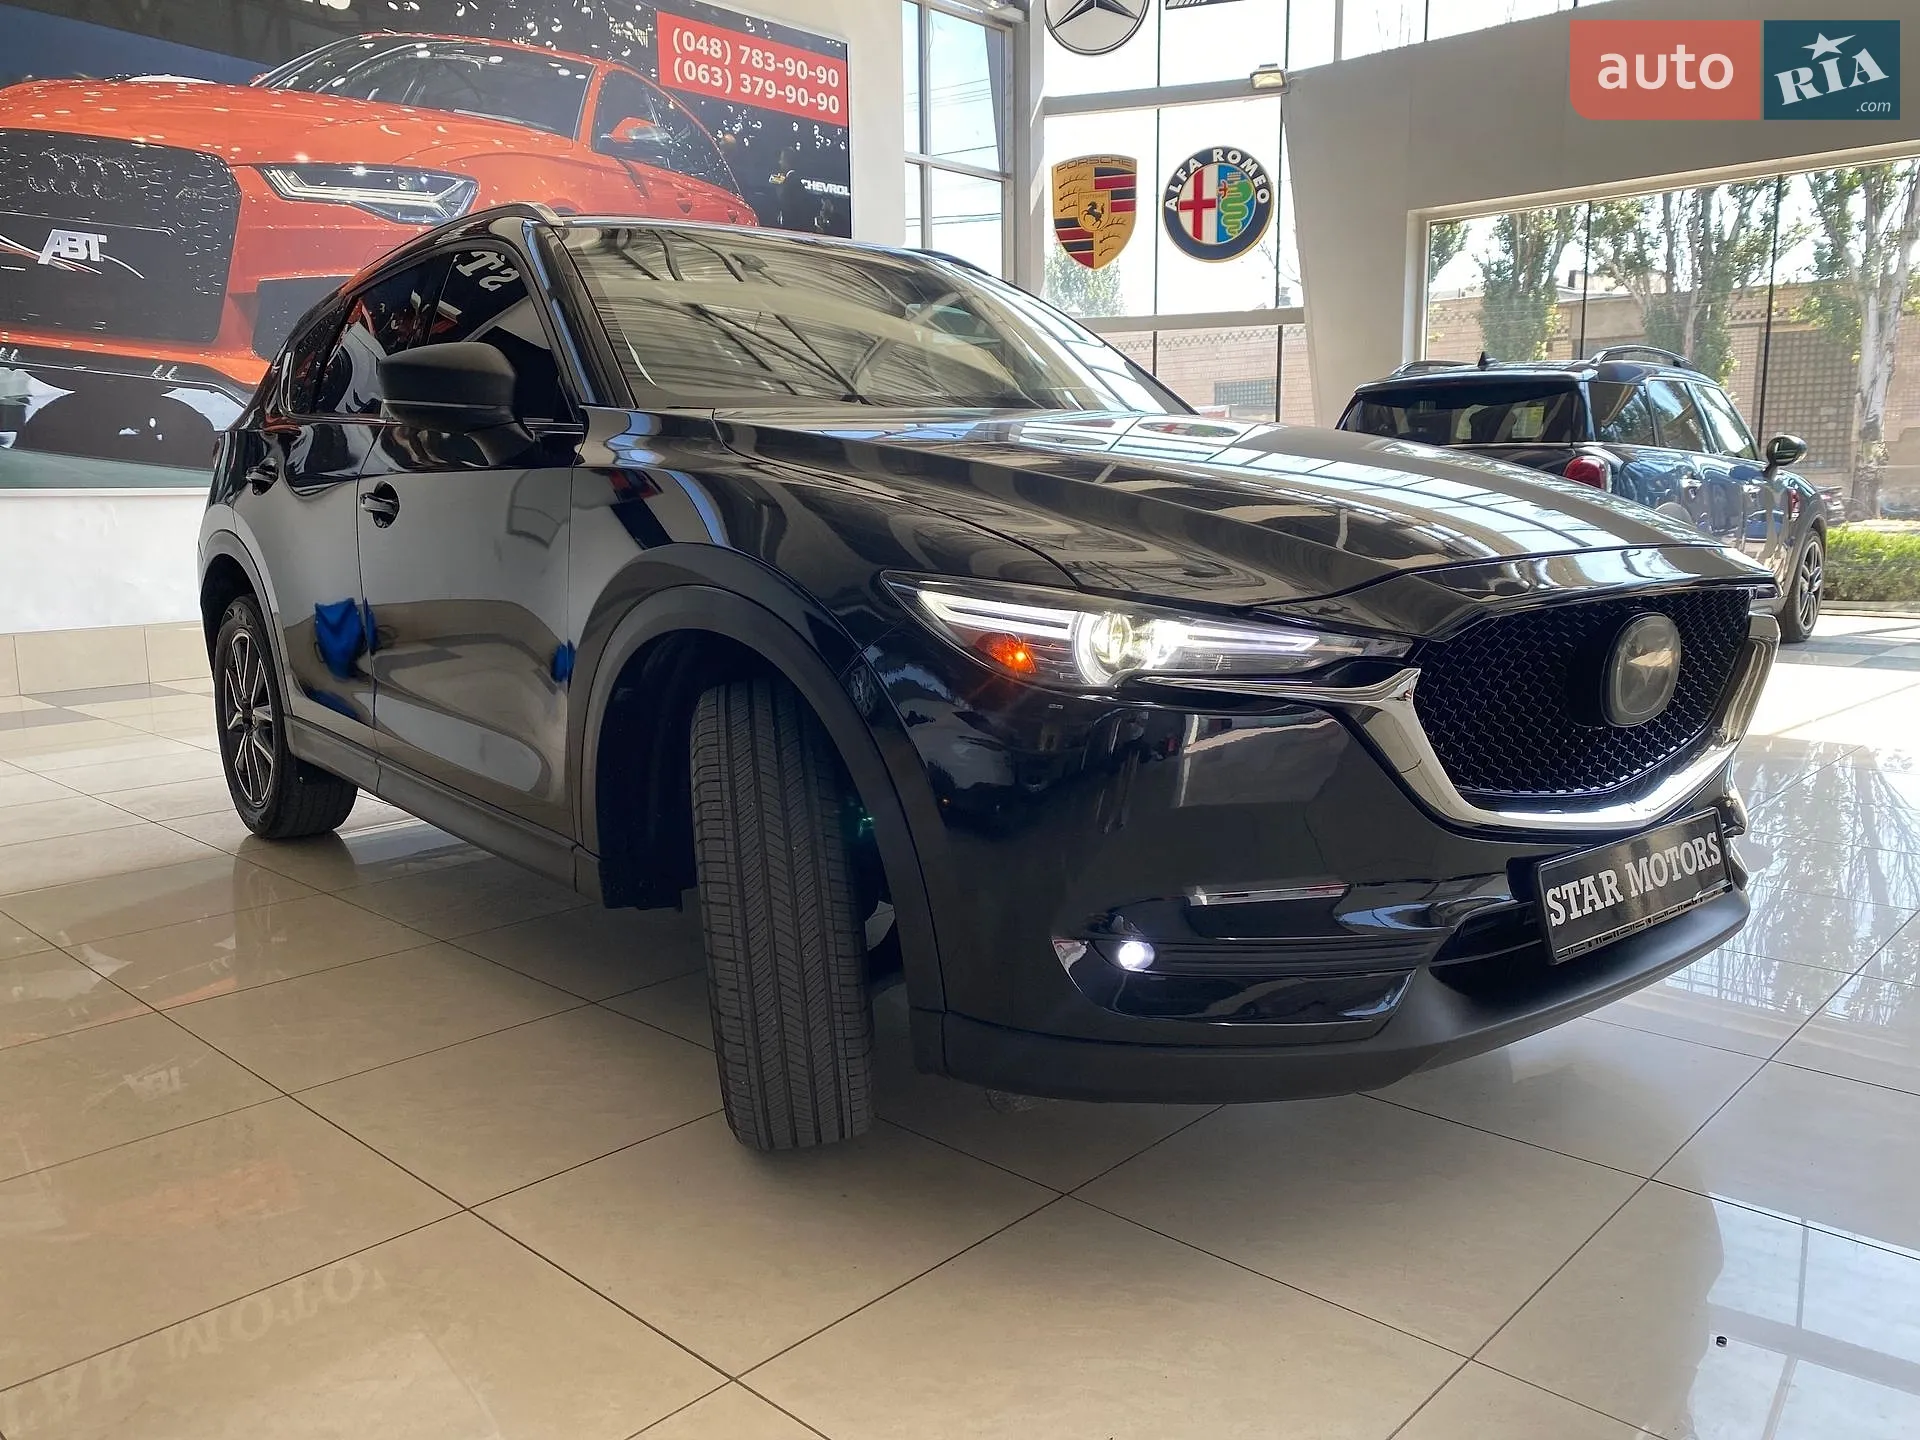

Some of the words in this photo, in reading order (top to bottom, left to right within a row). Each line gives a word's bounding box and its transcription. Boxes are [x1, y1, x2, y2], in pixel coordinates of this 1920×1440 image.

[672, 27, 732, 65] (048)
[739, 44, 839, 88] 783-90-90
[673, 57, 733, 94] (063)
[739, 73, 840, 114] 379-90-90
[1056, 156, 1134, 174] PORSCHE
[1165, 157, 1202, 212] ALFA
[1212, 148, 1270, 204] ROMEO
[38, 229, 107, 264] ABT
[1546, 869, 1623, 927] STAR
[1624, 831, 1722, 898] MOTORS
